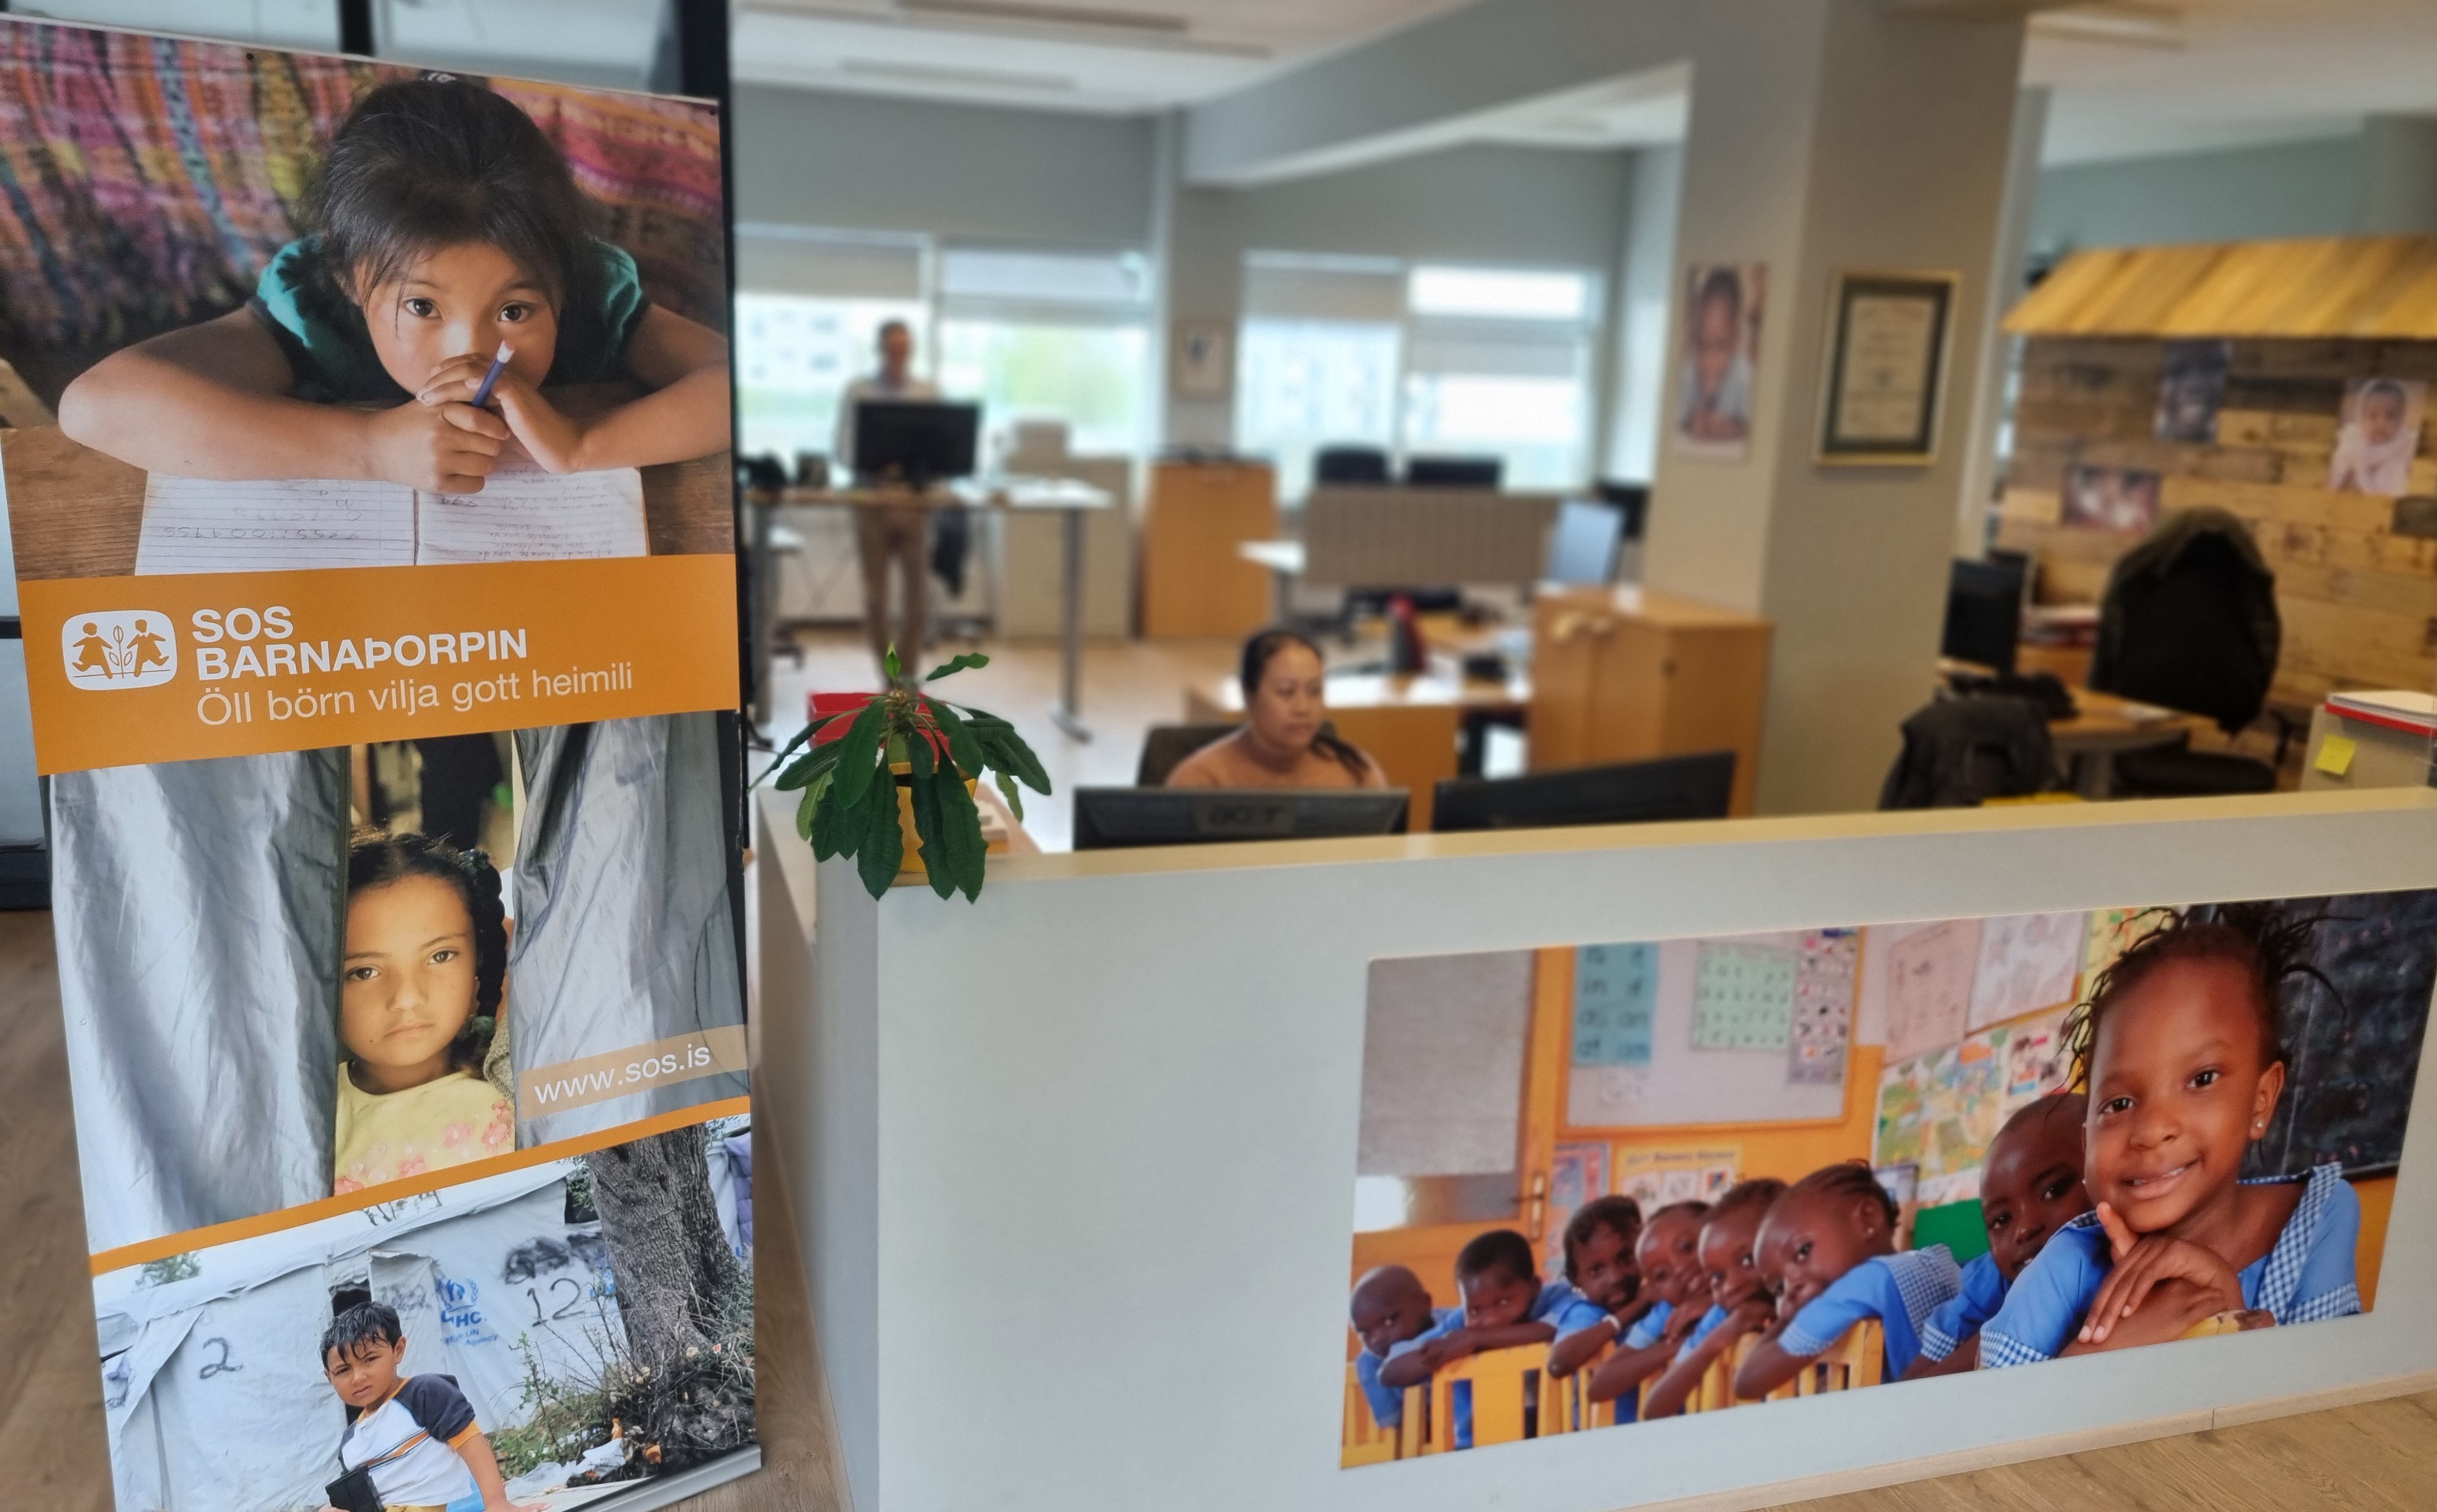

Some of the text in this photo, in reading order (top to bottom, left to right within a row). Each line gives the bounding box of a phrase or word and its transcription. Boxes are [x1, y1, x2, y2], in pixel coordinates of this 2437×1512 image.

[192, 606, 294, 643] SOS
[196, 628, 527, 681] BARNAÞORPIN
[197, 661, 632, 725] Öll börn vilja gott heimili
[534, 1043, 711, 1104] www.sos.is
[527, 1277, 585, 1327] 12
[199, 1337, 244, 1380] 2
